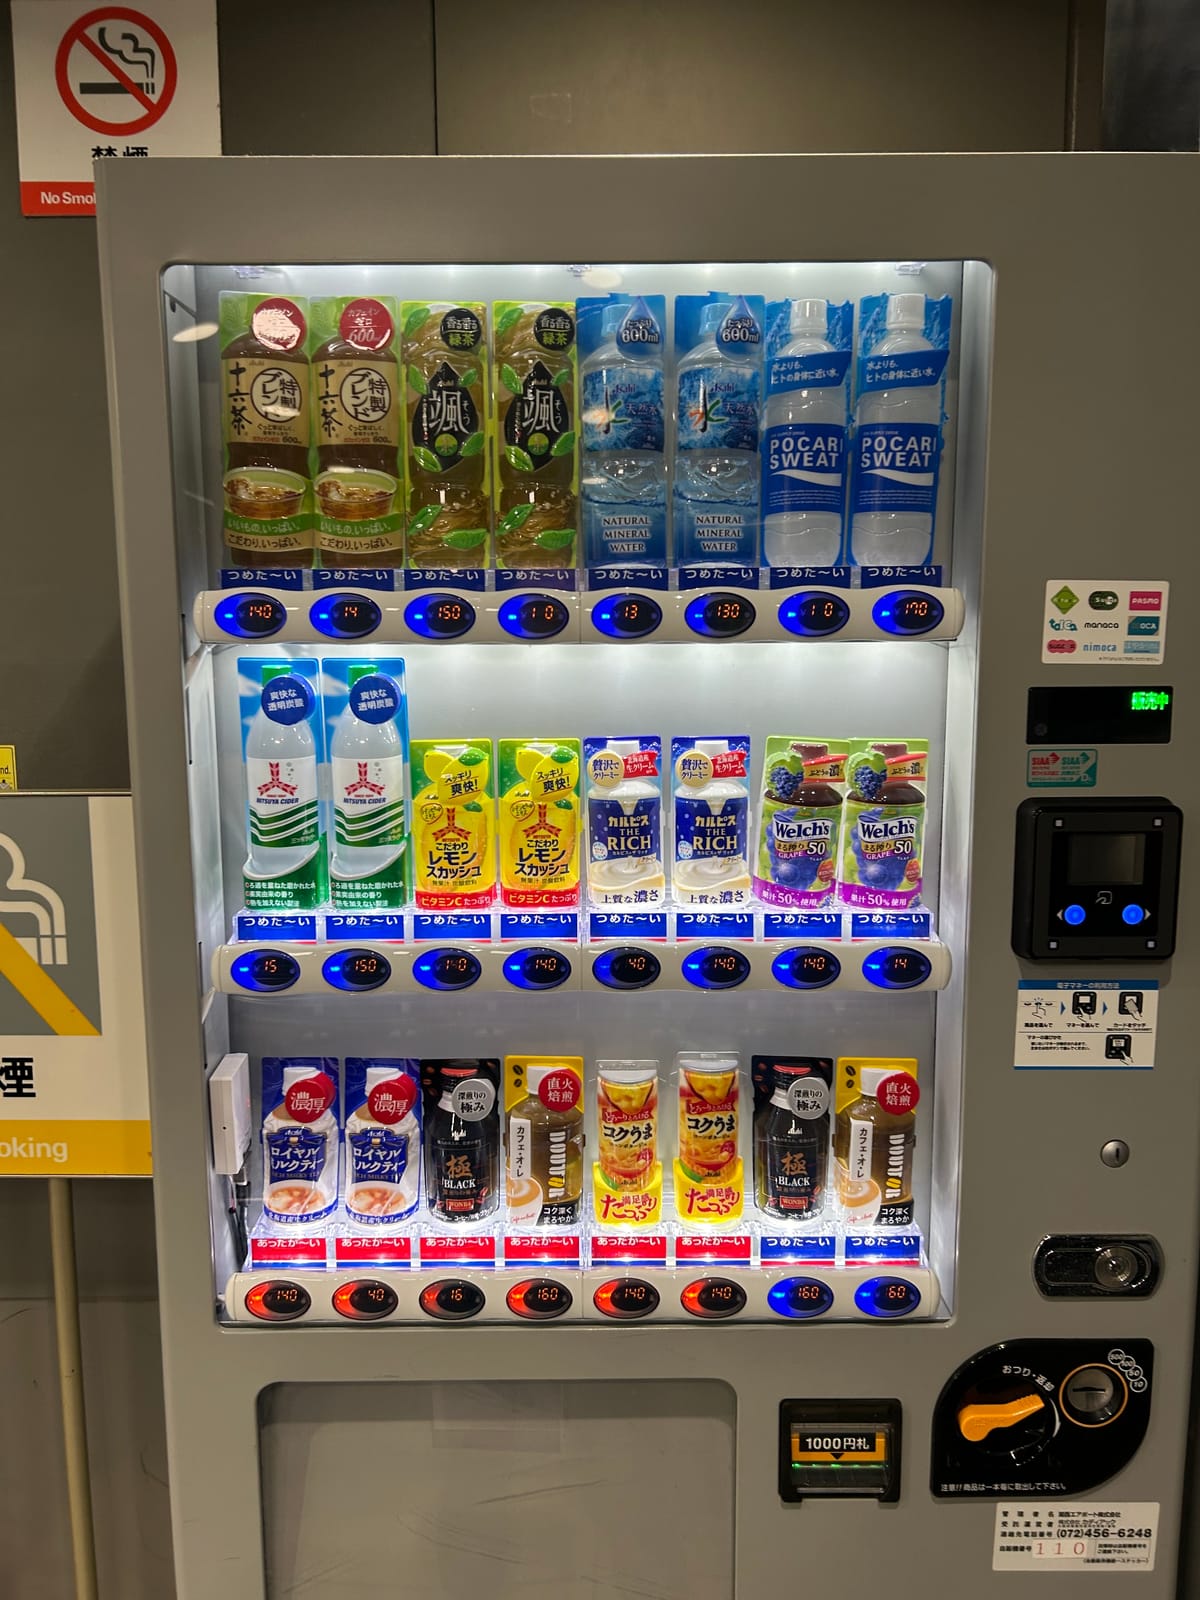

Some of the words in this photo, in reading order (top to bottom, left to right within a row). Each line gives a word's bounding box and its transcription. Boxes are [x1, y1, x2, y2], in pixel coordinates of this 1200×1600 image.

[41, 192, 60, 204] No
[63, 192, 96, 204] Smo
[354, 317, 373, 326] ゼロ
[447, 316, 477, 329] 香る香る
[540, 316, 571, 329] 香る香る
[627, 320, 652, 328] たっぷり
[727, 319, 753, 328] たっぷり
[450, 332, 475, 346] 緑茶
[543, 332, 568, 346] 緑茶
[621, 328, 659, 343] 600ml
[722, 328, 759, 343] 600ml
[772, 361, 803, 371] 水よりも、
[867, 360, 898, 370] 水よりも、
[771, 368, 840, 385] ヒトの身体に近い水。
[866, 367, 936, 383] ヒトの身体に近い水。
[228, 362, 252, 436] 十六茶
[318, 364, 343, 438] 十六茶
[350, 372, 371, 419] ブレンド
[368, 379, 387, 413] 特製
[429, 389, 470, 434] 颯
[462, 401, 471, 426] そう
[522, 388, 559, 434] 颯
[555, 401, 562, 424] そう
[627, 403, 656, 415] 天然水
[726, 403, 755, 415] 天然水
[770, 436, 843, 454] POCARI
[862, 436, 936, 452] POCARI
[769, 452, 839, 470] SWEAT
[861, 452, 932, 468] SWEAT
[603, 517, 650, 525] NATURAL
[696, 515, 742, 525] NATURAL
[604, 530, 650, 538] MINERAL
[696, 528, 742, 537] MINERAL
[228, 535, 301, 548] こだわり、いっぱい。
[320, 537, 392, 550] こだわり、いっぱい。
[611, 543, 645, 552] WATER
[702, 542, 737, 551] WATER
[249, 604, 272, 619] 140
[438, 605, 460, 619] 150
[717, 603, 740, 618] 130
[905, 602, 927, 615] 170
[1083, 642, 1117, 652] nimoca
[270, 689, 297, 700] 爽快な
[360, 689, 388, 700] 爽快な
[267, 698, 304, 711] 透明炭酸
[358, 698, 395, 711] 透明炭酸
[1131, 692, 1169, 711] 販売中
[592, 759, 619, 771] 贅沢で
[626, 764, 654, 774] 生クリーム
[681, 759, 708, 771] 贅沢で
[715, 763, 744, 773] 生クリーム
[445, 770, 471, 783] スッキリ
[537, 768, 563, 780] スッキリ
[593, 771, 619, 780] クリーミー
[681, 771, 708, 780] クリーミー
[451, 780, 478, 796] 爽快!
[543, 776, 570, 792] 爽快!
[608, 815, 649, 828] カルピス
[695, 815, 737, 828] カルピス
[775, 820, 830, 839] Welch's
[860, 819, 915, 839] Welch's
[436, 842, 469, 851] こだわり
[527, 840, 558, 848] こだわり
[607, 835, 651, 851] RICH
[693, 835, 737, 851] RICH
[776, 843, 804, 851] まる搾り
[806, 841, 826, 855] 50
[863, 843, 892, 851] まる搾り
[894, 840, 913, 854] 50
[429, 851, 477, 865] レモン
[519, 848, 566, 862] レモン
[778, 851, 803, 859] GRAPE
[866, 851, 891, 860] GRAPE
[427, 866, 482, 879] スカッシュ
[515, 863, 569, 876] スカッシュ
[422, 896, 462, 905] ビタミンC
[464, 896, 491, 904] たっぷり
[509, 894, 550, 903] ビタミンC
[551, 894, 578, 903] たっぷり
[602, 889, 658, 904] 上質な濃さ
[688, 890, 744, 904] 上質な濃さ
[762, 891, 818, 907] 果汁50%使用
[851, 892, 907, 906] 果汁50%使用
[355, 959, 377, 972] 150
[535, 958, 557, 970] 140
[713, 957, 736, 969] 140
[804, 957, 825, 969] 140
[547, 1078, 573, 1090] 直火
[886, 1082, 911, 1094] 直火
[458, 1091, 486, 1100] 深煎りの
[547, 1091, 573, 1103] 焙煎
[794, 1090, 822, 1098] 深煎りの
[886, 1094, 911, 1107] 焙煎
[290, 1091, 326, 1115] 濃厚
[373, 1092, 409, 1116] 濃厚
[460, 1102, 485, 1113] 極み
[796, 1100, 821, 1111] 極み
[687, 1115, 735, 1135] コクうま
[603, 1122, 653, 1143] コクうま
[271, 1146, 320, 1160] ロイヤル
[353, 1147, 402, 1160] ロイヤル
[516, 1125, 525, 1178] カフェ・オ・レ
[857, 1128, 868, 1178] カフェ・オ・レ
[447, 1155, 472, 1178] 極
[781, 1151, 807, 1175] 極
[444, 1179, 476, 1189] BLACK
[778, 1176, 811, 1186] BLACK
[622, 1194, 651, 1205] 満足感
[706, 1188, 735, 1200] 満足感
[601, 1194, 657, 1221] たっぷり
[685, 1188, 740, 1215] たっぷり
[543, 1207, 573, 1215] コク深く
[881, 1207, 909, 1215] コク深く
[543, 1215, 573, 1224] まろやか
[881, 1216, 909, 1224] まろやか
[276, 1289, 298, 1301] 140
[450, 1289, 462, 1301] 16
[538, 1288, 558, 1300] 160
[624, 1287, 645, 1299] 140
[712, 1287, 731, 1299] 140
[798, 1287, 820, 1299] 160
[1002, 1365, 1055, 1392] おつり・返却
[805, 1437, 870, 1450] 1000円札
[1056, 1528, 1152, 1539] (072)456-6248
